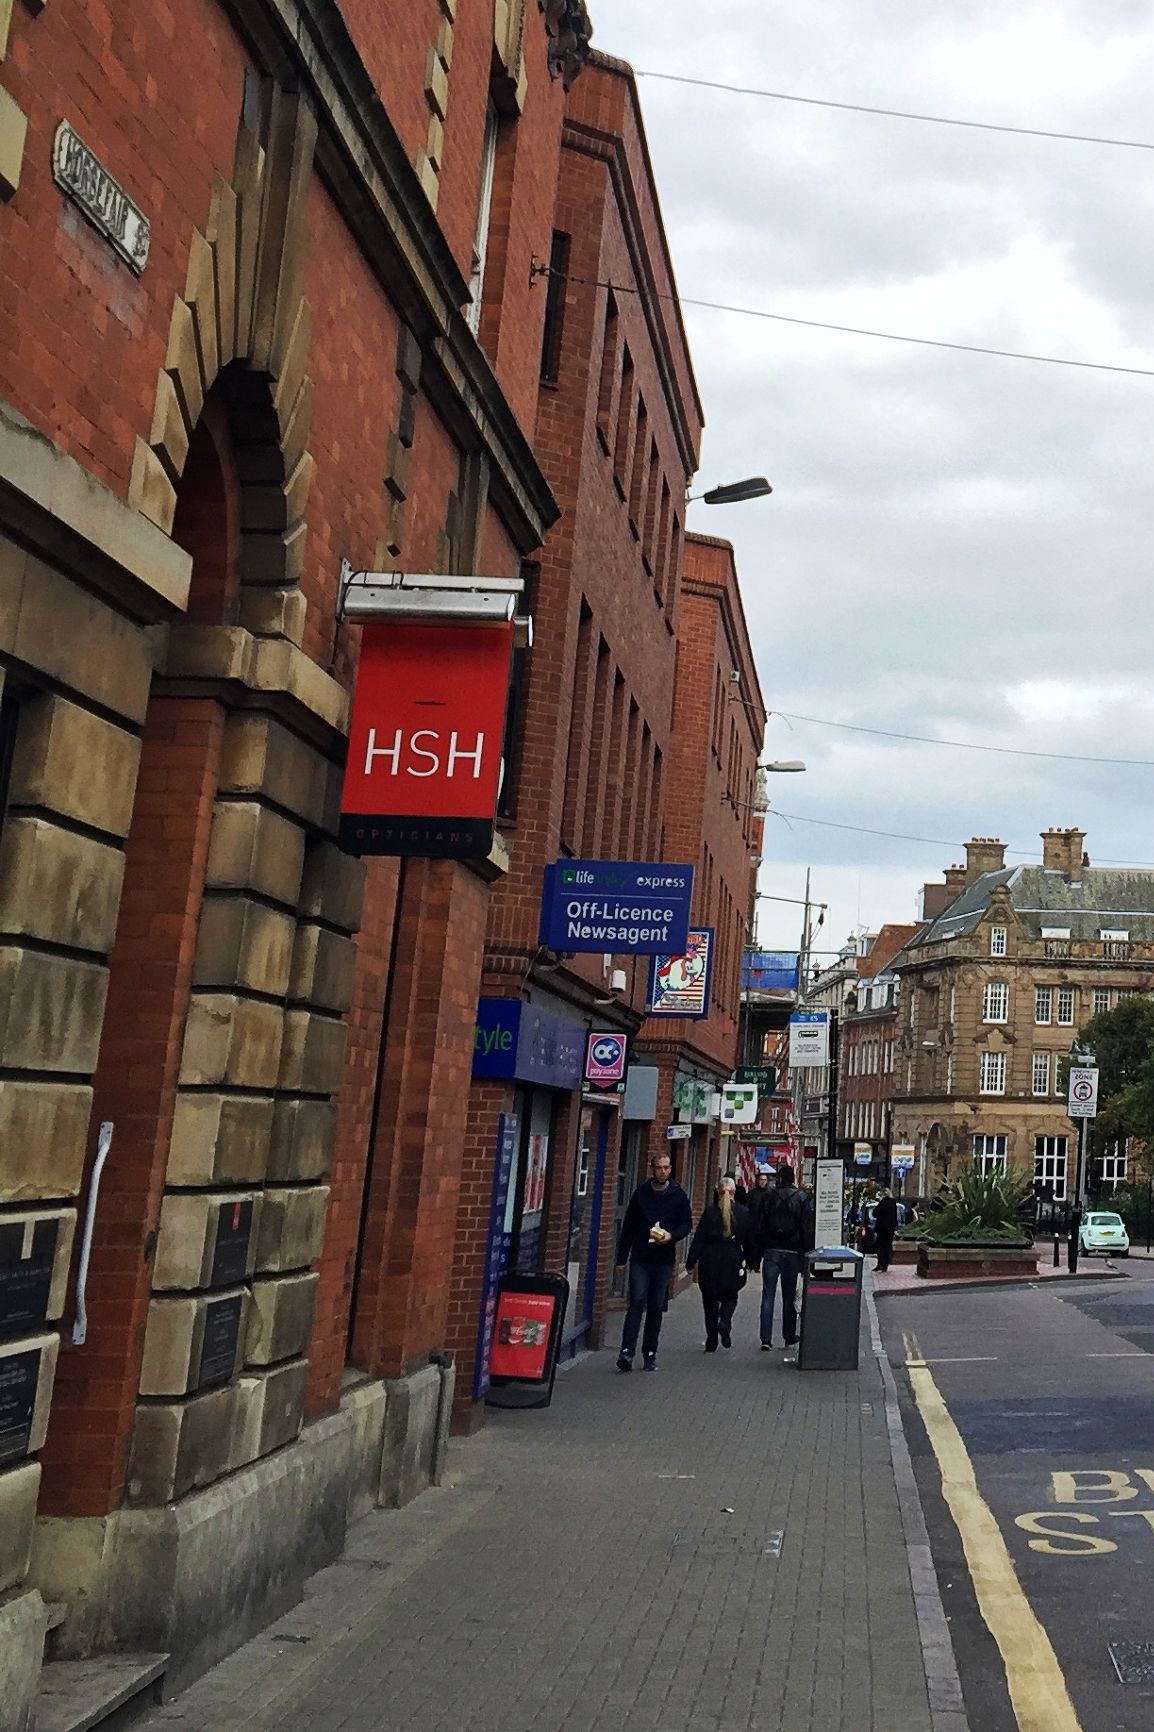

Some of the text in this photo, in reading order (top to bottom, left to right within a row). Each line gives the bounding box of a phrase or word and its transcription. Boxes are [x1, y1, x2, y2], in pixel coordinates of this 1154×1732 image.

[364, 728, 484, 779] HSH
[355, 828, 474, 843] OPTICIANS
[575, 870, 595, 884] life
[636, 876, 685, 889] express
[567, 901, 674, 922] Off-Licence
[567, 921, 668, 944] Newsagent
